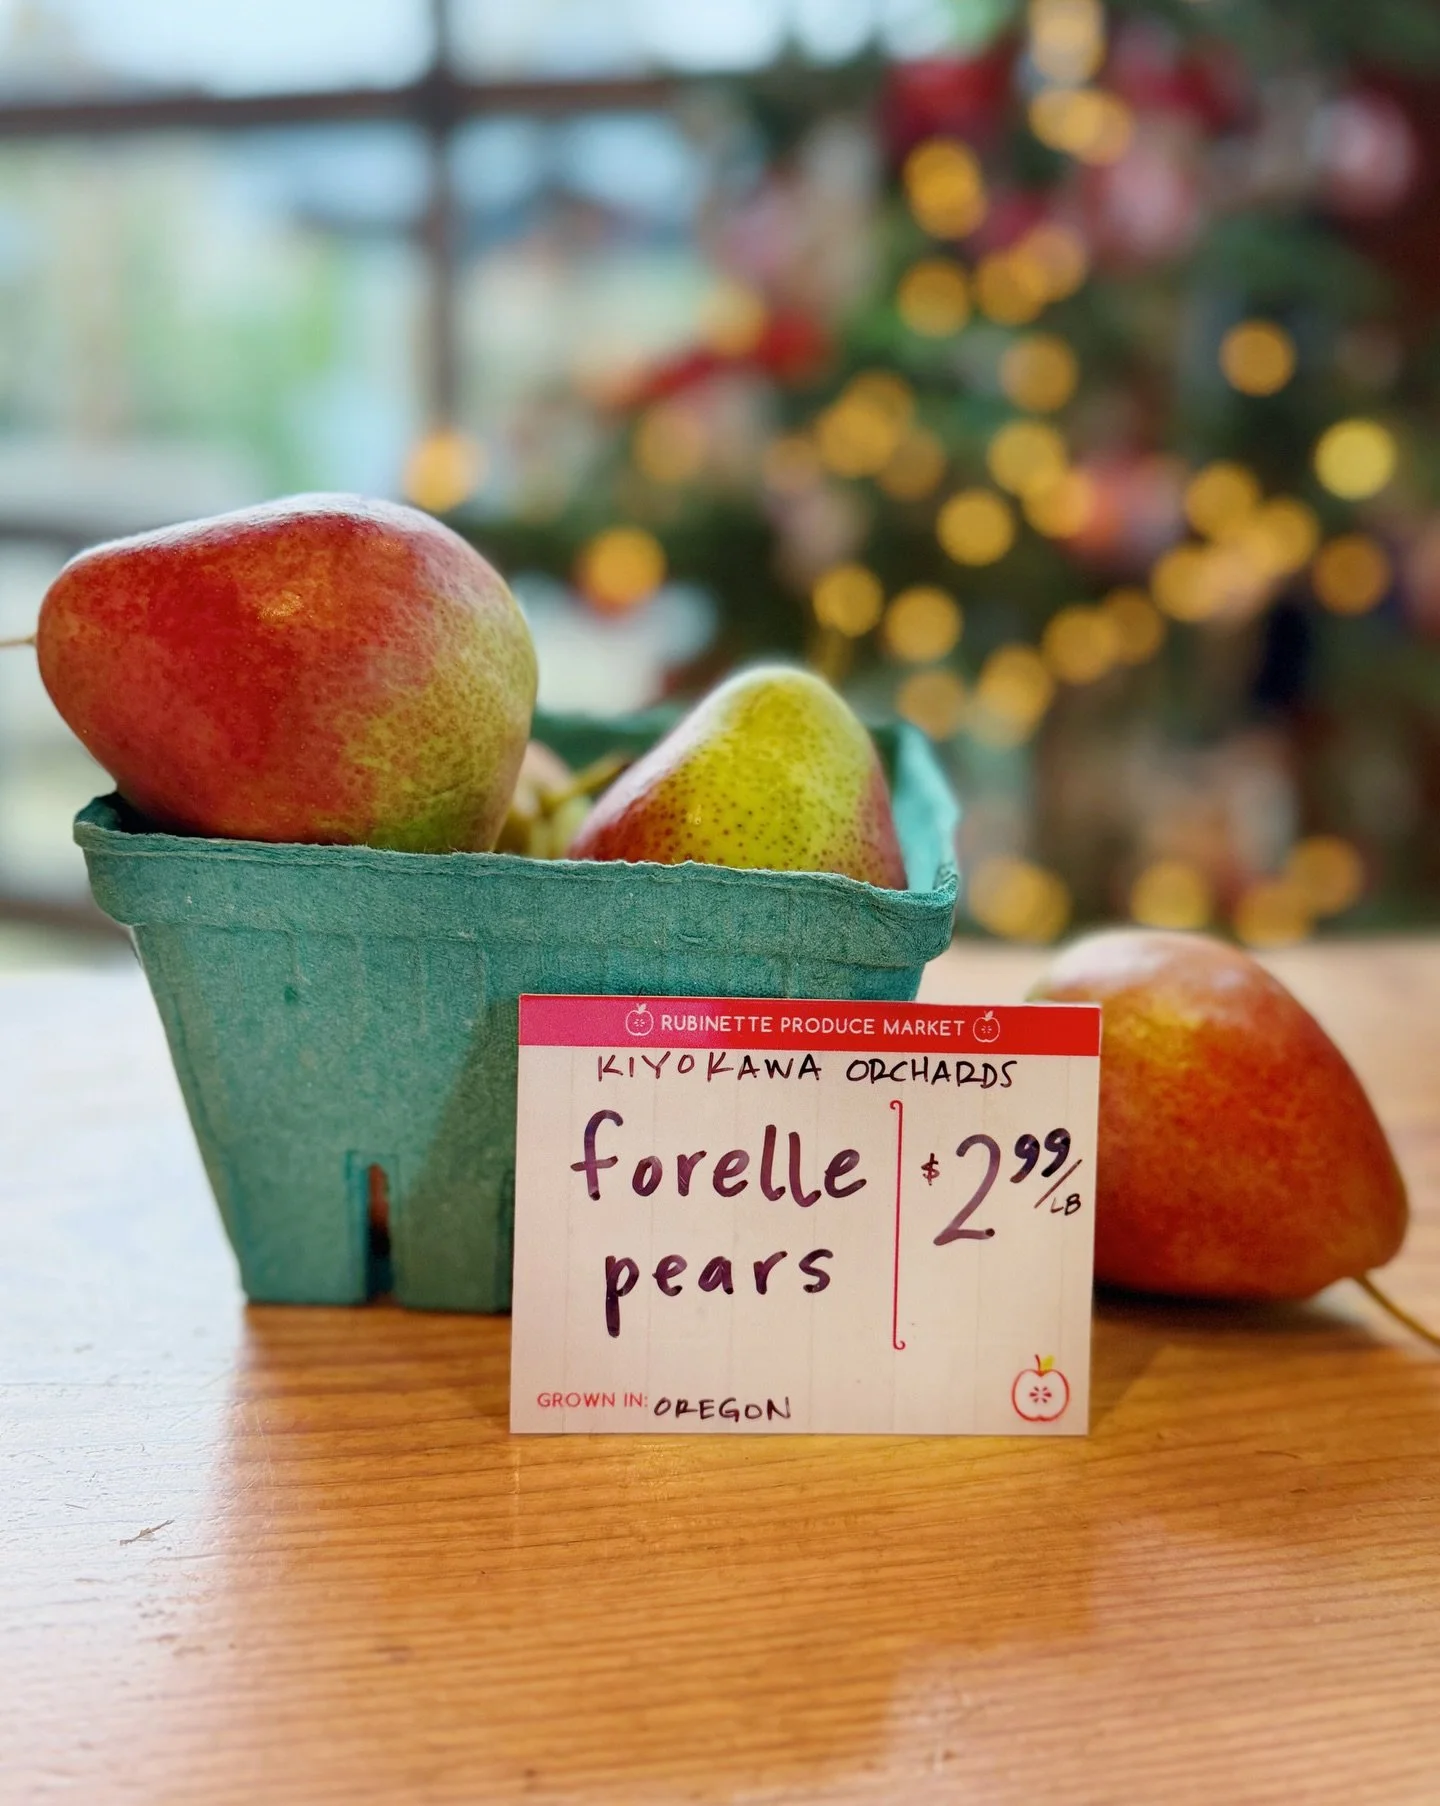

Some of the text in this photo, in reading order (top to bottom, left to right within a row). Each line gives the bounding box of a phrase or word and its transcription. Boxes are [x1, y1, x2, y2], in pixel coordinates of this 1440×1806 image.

[661, 1014, 965, 1036] RUBINETTE PRODUCE MARKET
[597, 1051, 1017, 1089] KIYOKAWA ORCHARDS
[570, 1109, 867, 1207] forelle
[605, 1248, 833, 1338] pears
[537, 1392, 791, 1422] GROWN IN: OREGON
